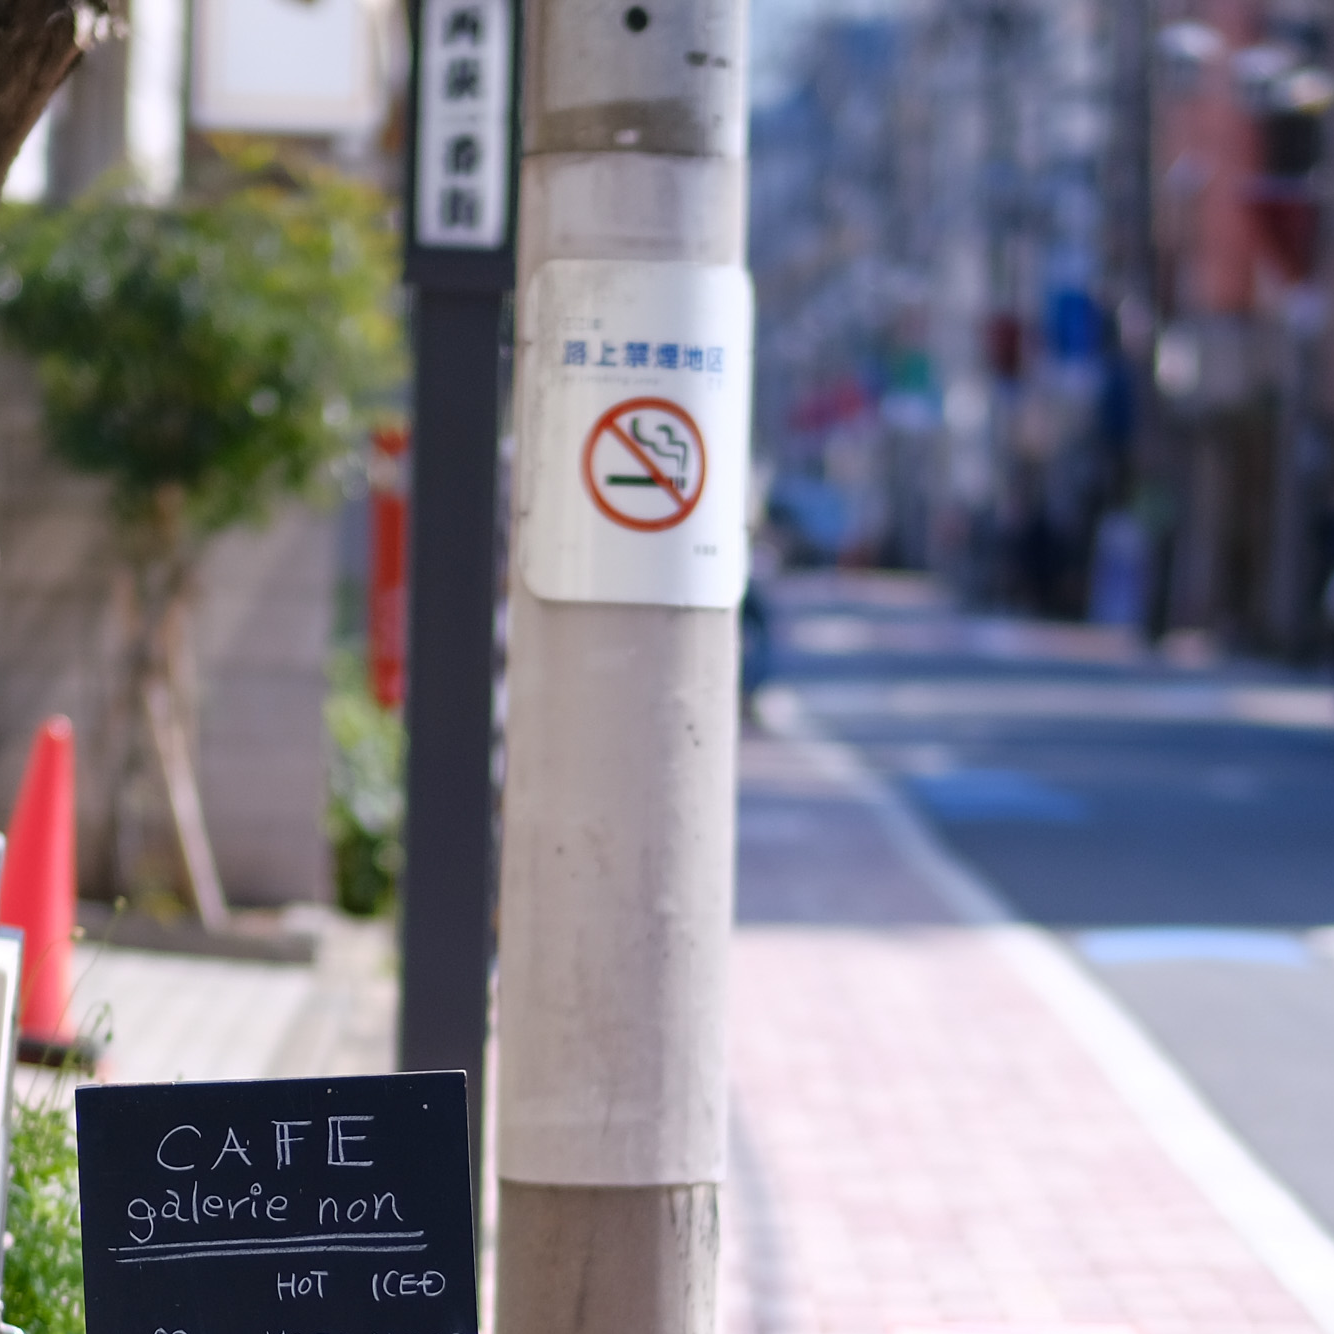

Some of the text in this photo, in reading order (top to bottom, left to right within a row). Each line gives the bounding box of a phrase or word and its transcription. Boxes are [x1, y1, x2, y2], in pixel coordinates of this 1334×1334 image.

[561, 340, 724, 373] 路上禁煙地区
[157, 1115, 375, 1170] CAFE
[128, 1181, 403, 1244] galerie non
[277, 1269, 446, 1300] HOT ICED
